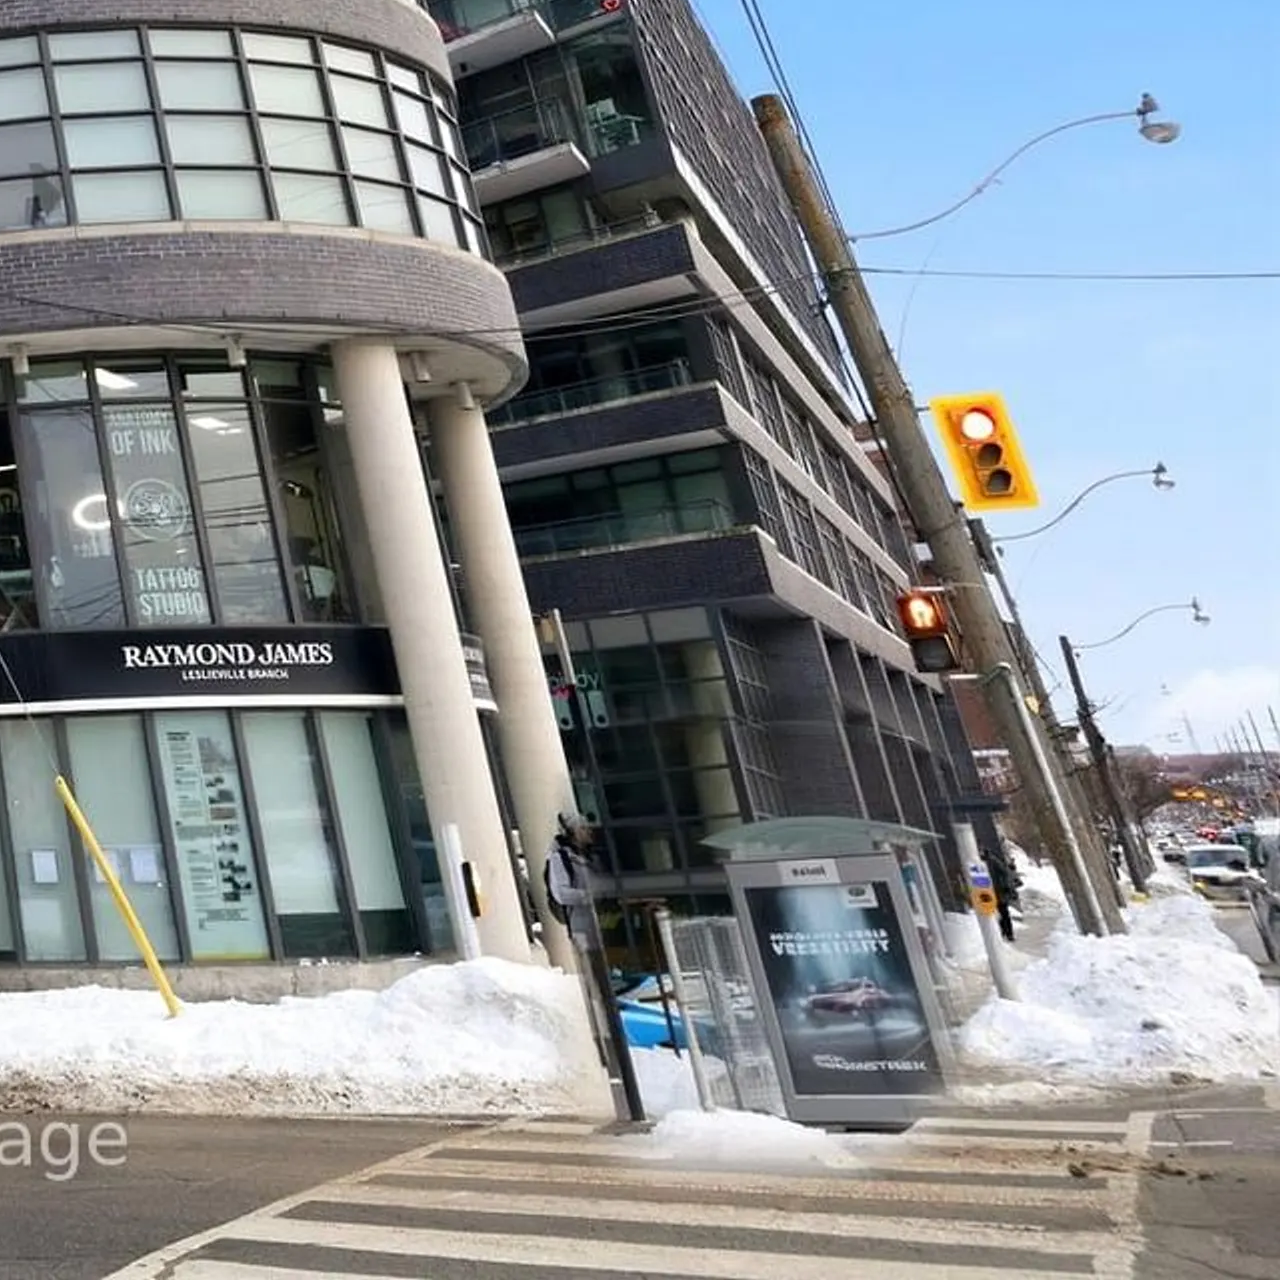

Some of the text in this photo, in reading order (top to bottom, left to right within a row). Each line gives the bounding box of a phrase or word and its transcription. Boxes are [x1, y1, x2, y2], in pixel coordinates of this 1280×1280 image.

[111, 428, 176, 456] OF INK
[135, 567, 200, 591] TATTOO
[139, 591, 205, 617] STUDIO
[122, 642, 334, 668] RAYMOND JAMES
[182, 668, 289, 681] LESLIEVILLE BRANCH
